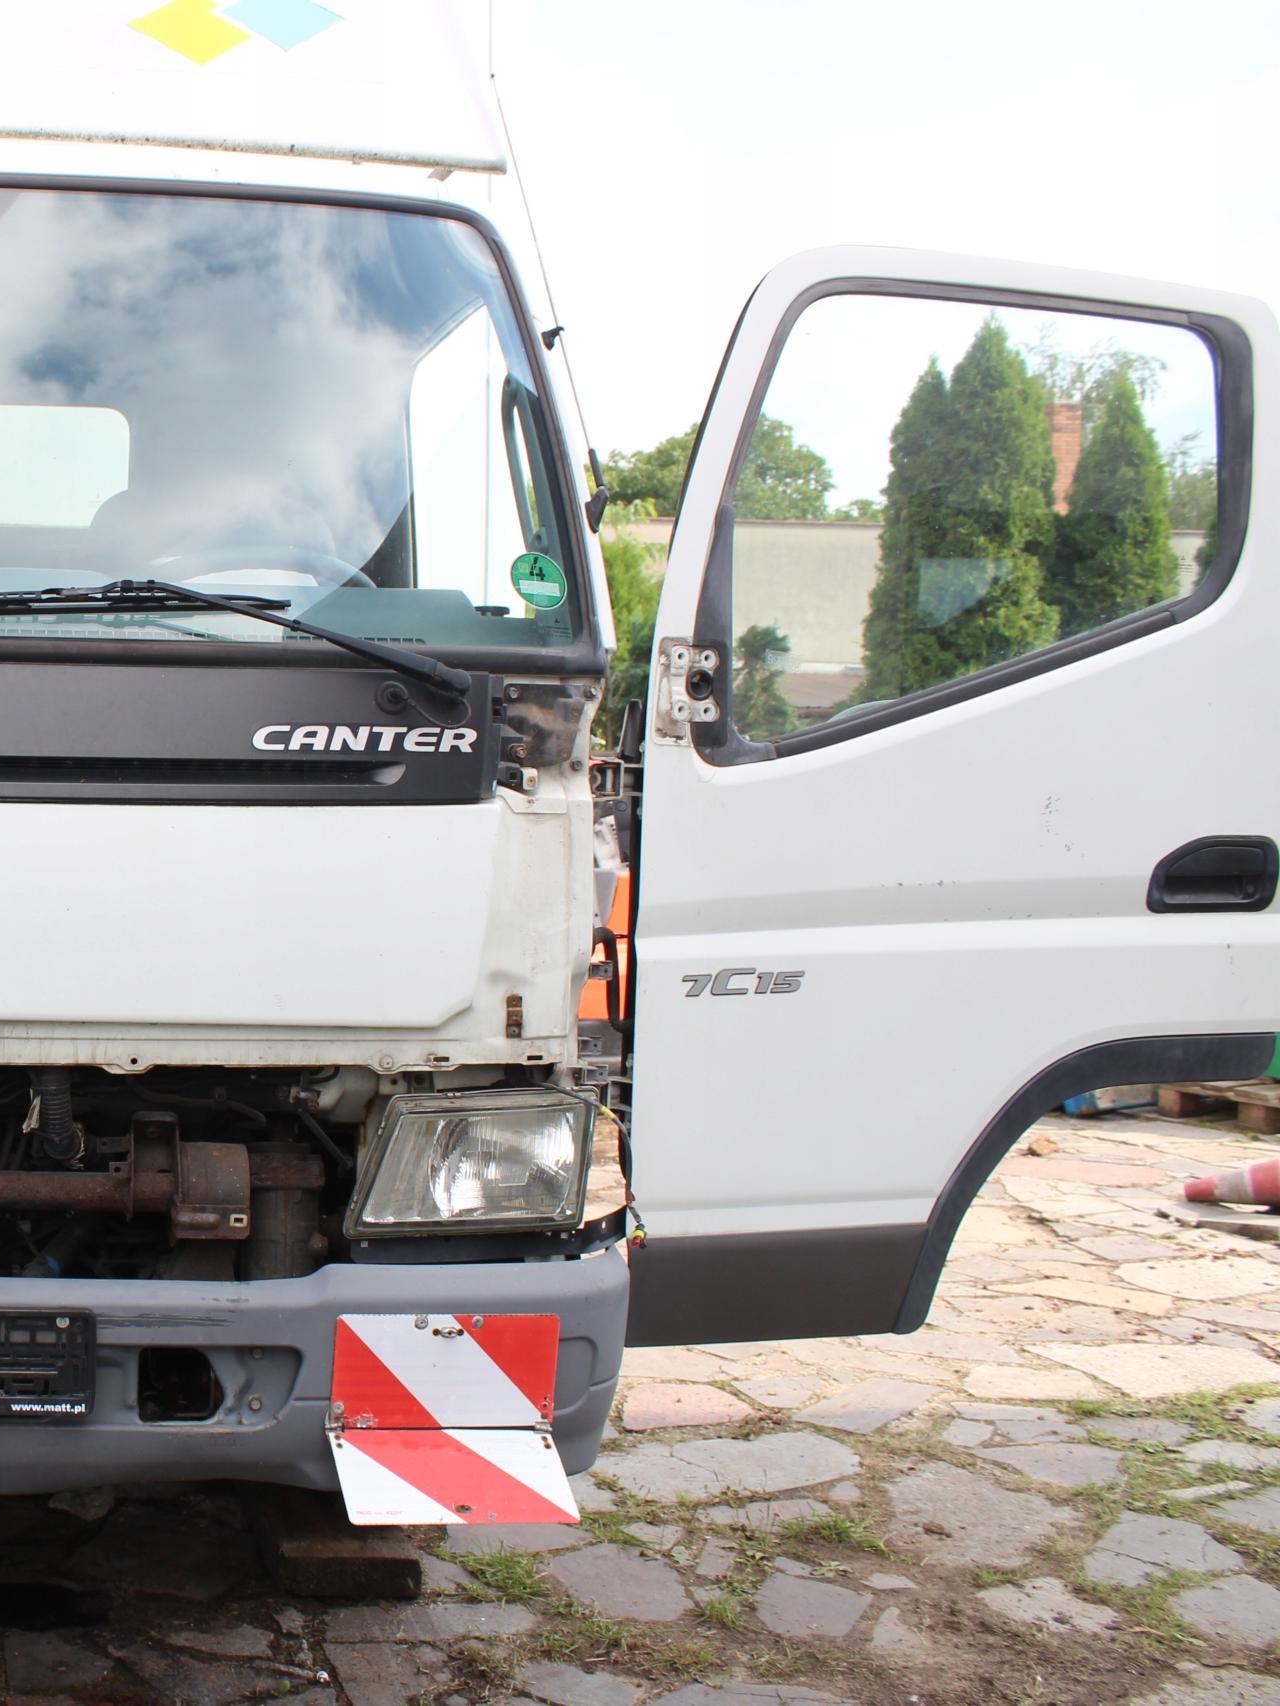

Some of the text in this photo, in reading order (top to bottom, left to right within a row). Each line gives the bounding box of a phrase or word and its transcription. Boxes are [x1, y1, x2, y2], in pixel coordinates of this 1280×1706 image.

[529, 556, 546, 581] 4
[252, 725, 478, 753] CANTER
[682, 967, 805, 997] 7C15
[11, 1403, 86, 1413] www.matt.pl
